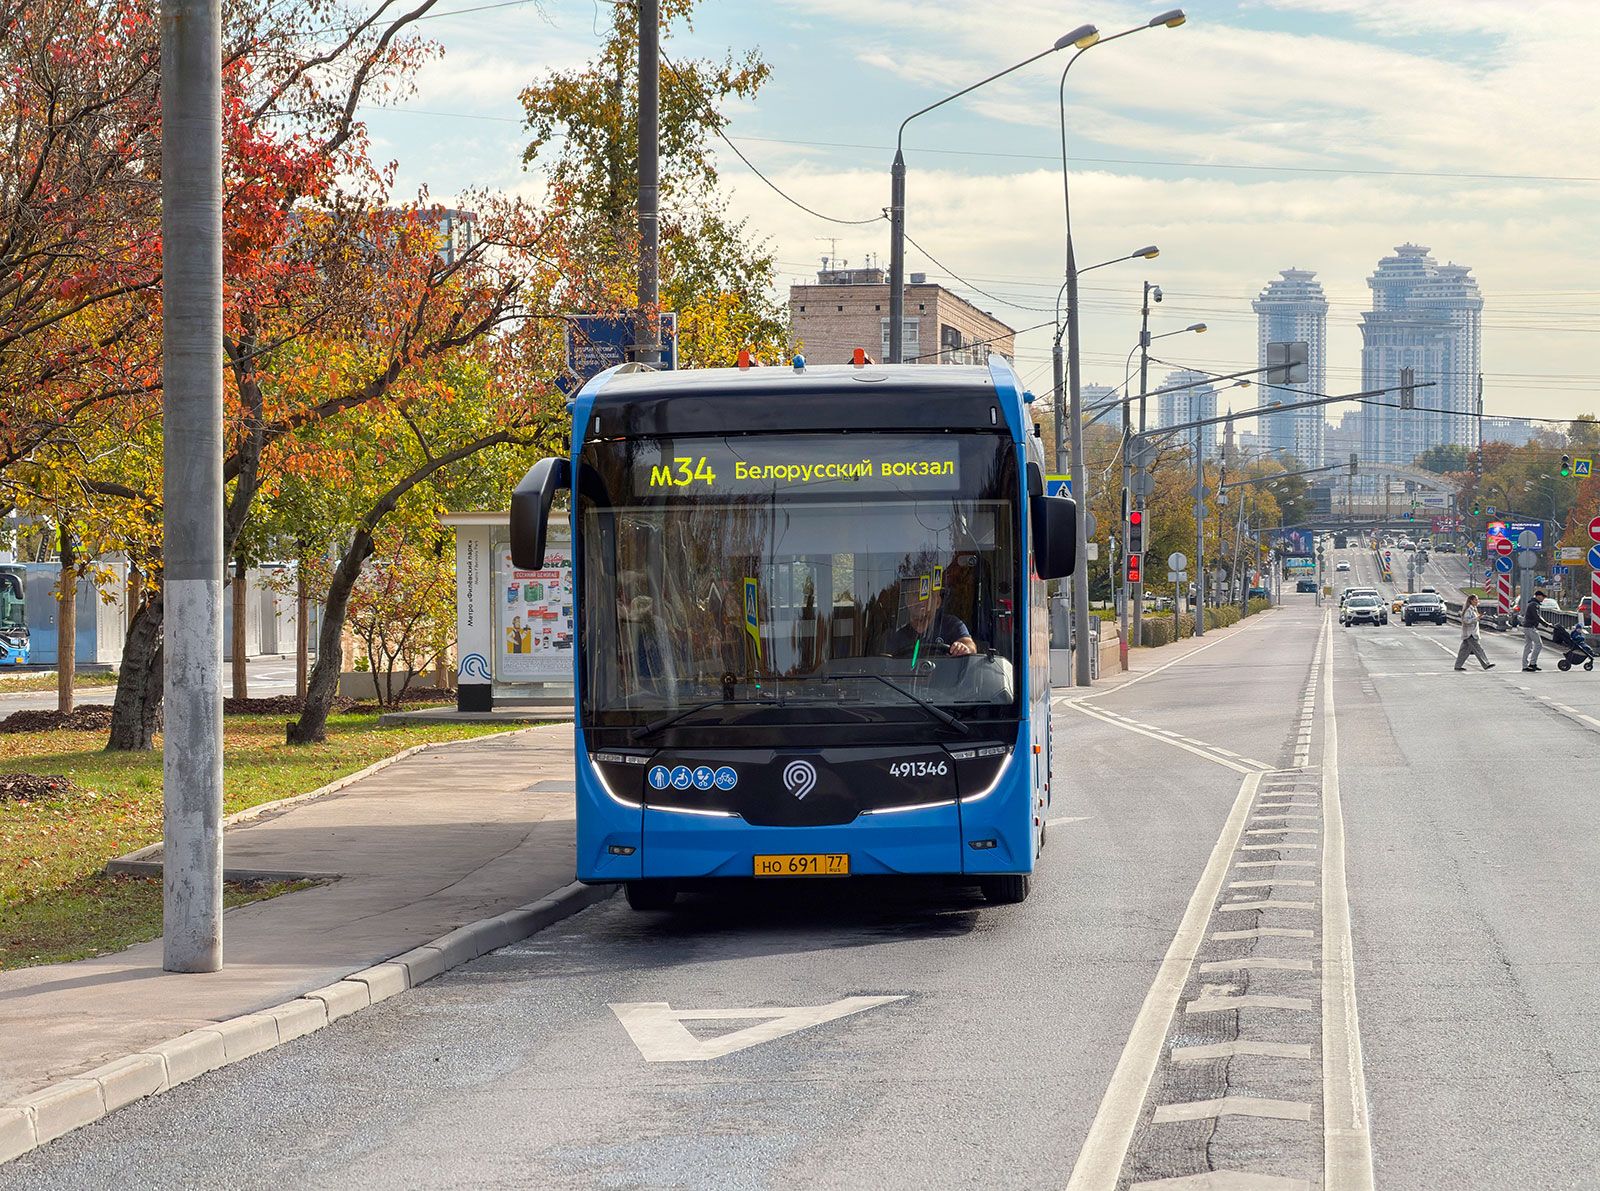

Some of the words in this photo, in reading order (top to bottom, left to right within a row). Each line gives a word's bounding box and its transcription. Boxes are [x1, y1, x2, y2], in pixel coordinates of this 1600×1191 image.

[735, 459, 873, 482] Белорусский
[881, 460, 955, 477] вокзал
[889, 761, 948, 777] 491346
[788, 857, 818, 873] 691
[827, 856, 843, 867] 77
